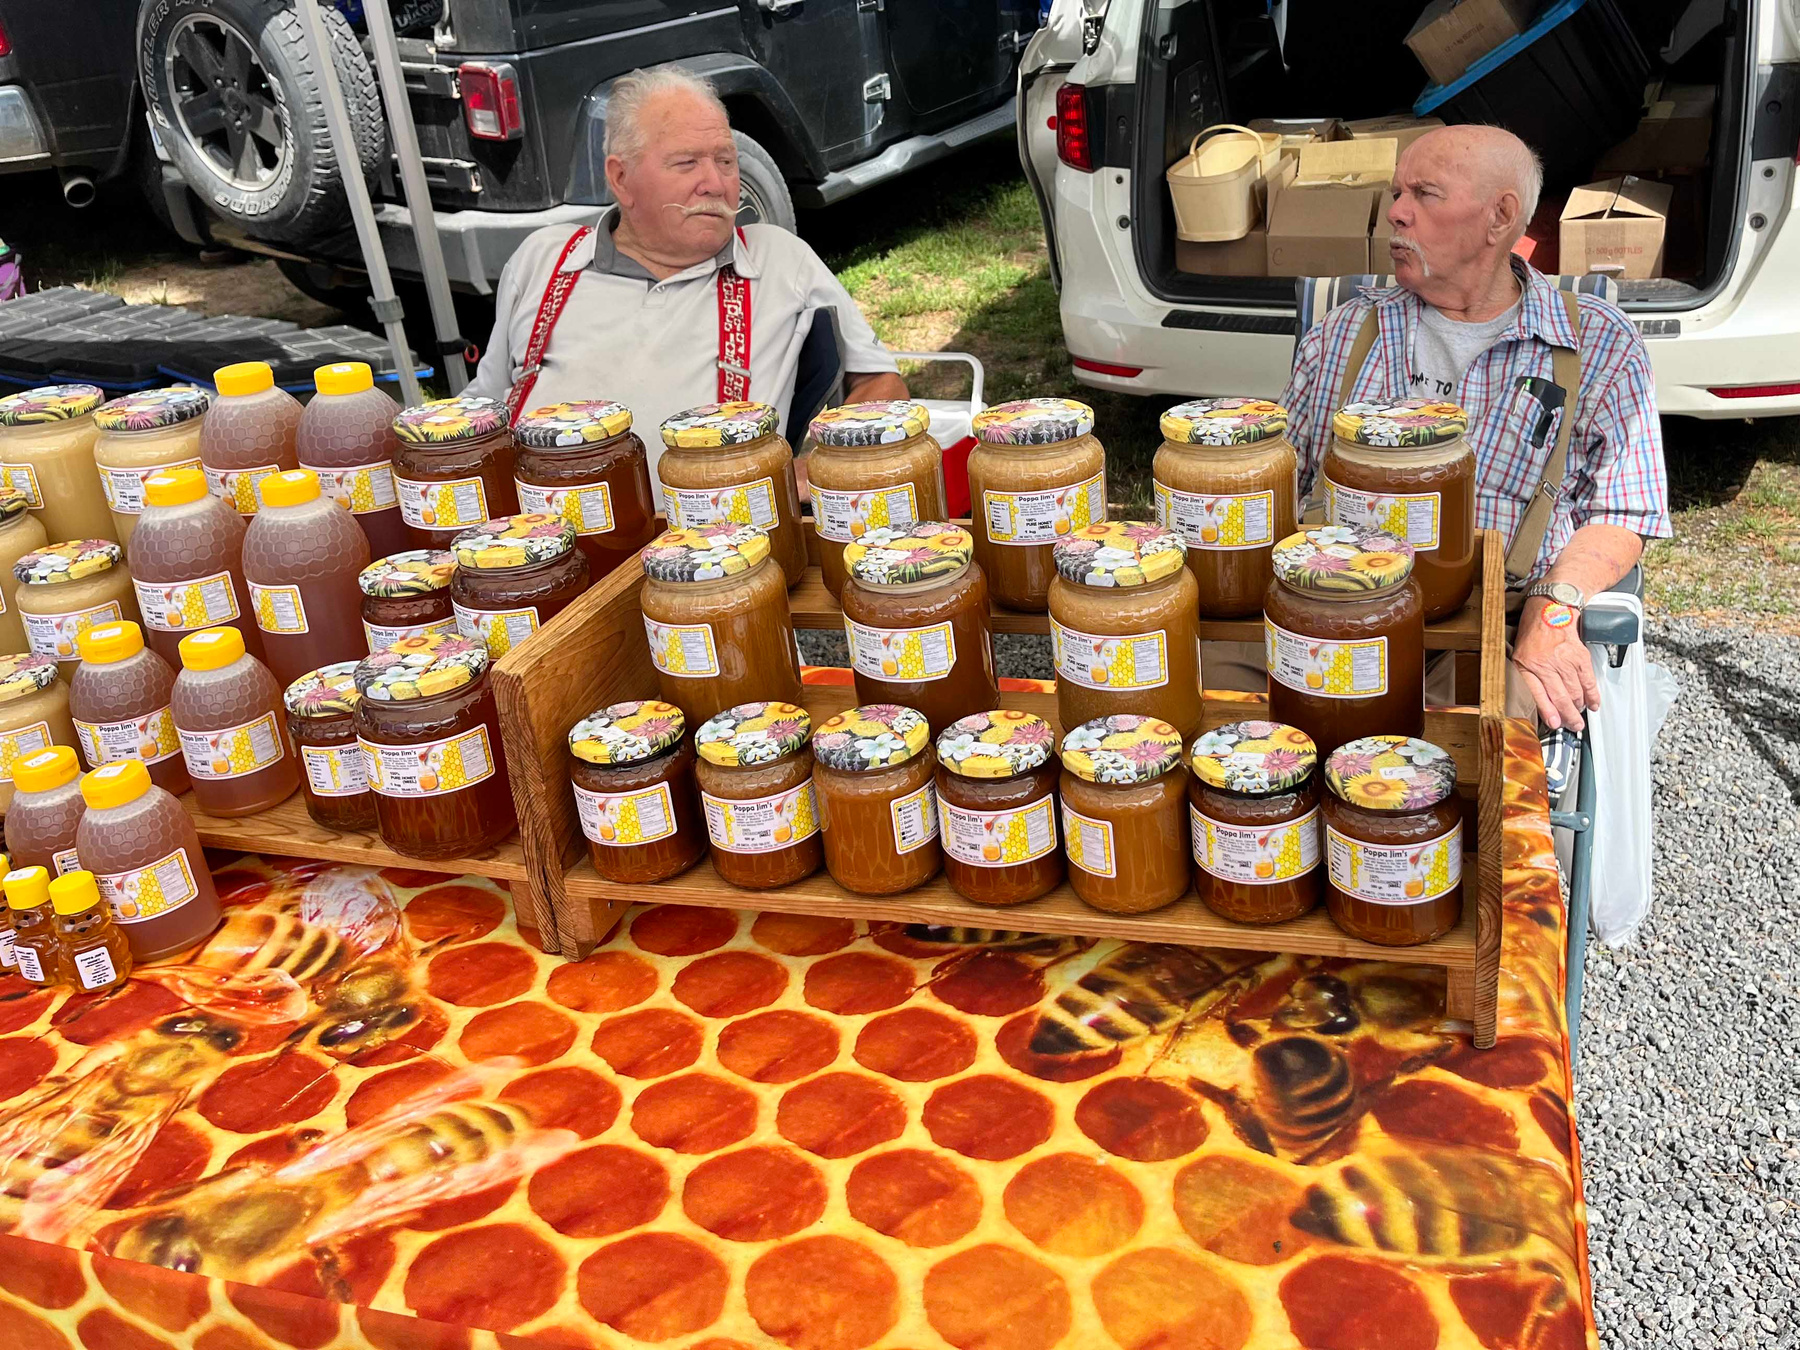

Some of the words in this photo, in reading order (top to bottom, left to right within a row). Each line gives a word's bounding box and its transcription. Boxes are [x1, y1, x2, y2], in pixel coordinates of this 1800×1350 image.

[1436, 380, 1452, 396] TO
[121, 722, 136, 731] Jim's
[756, 802, 772, 810] Jim's
[1216, 827, 1237, 838] Poppa
[1364, 848, 1387, 857] Poppa
